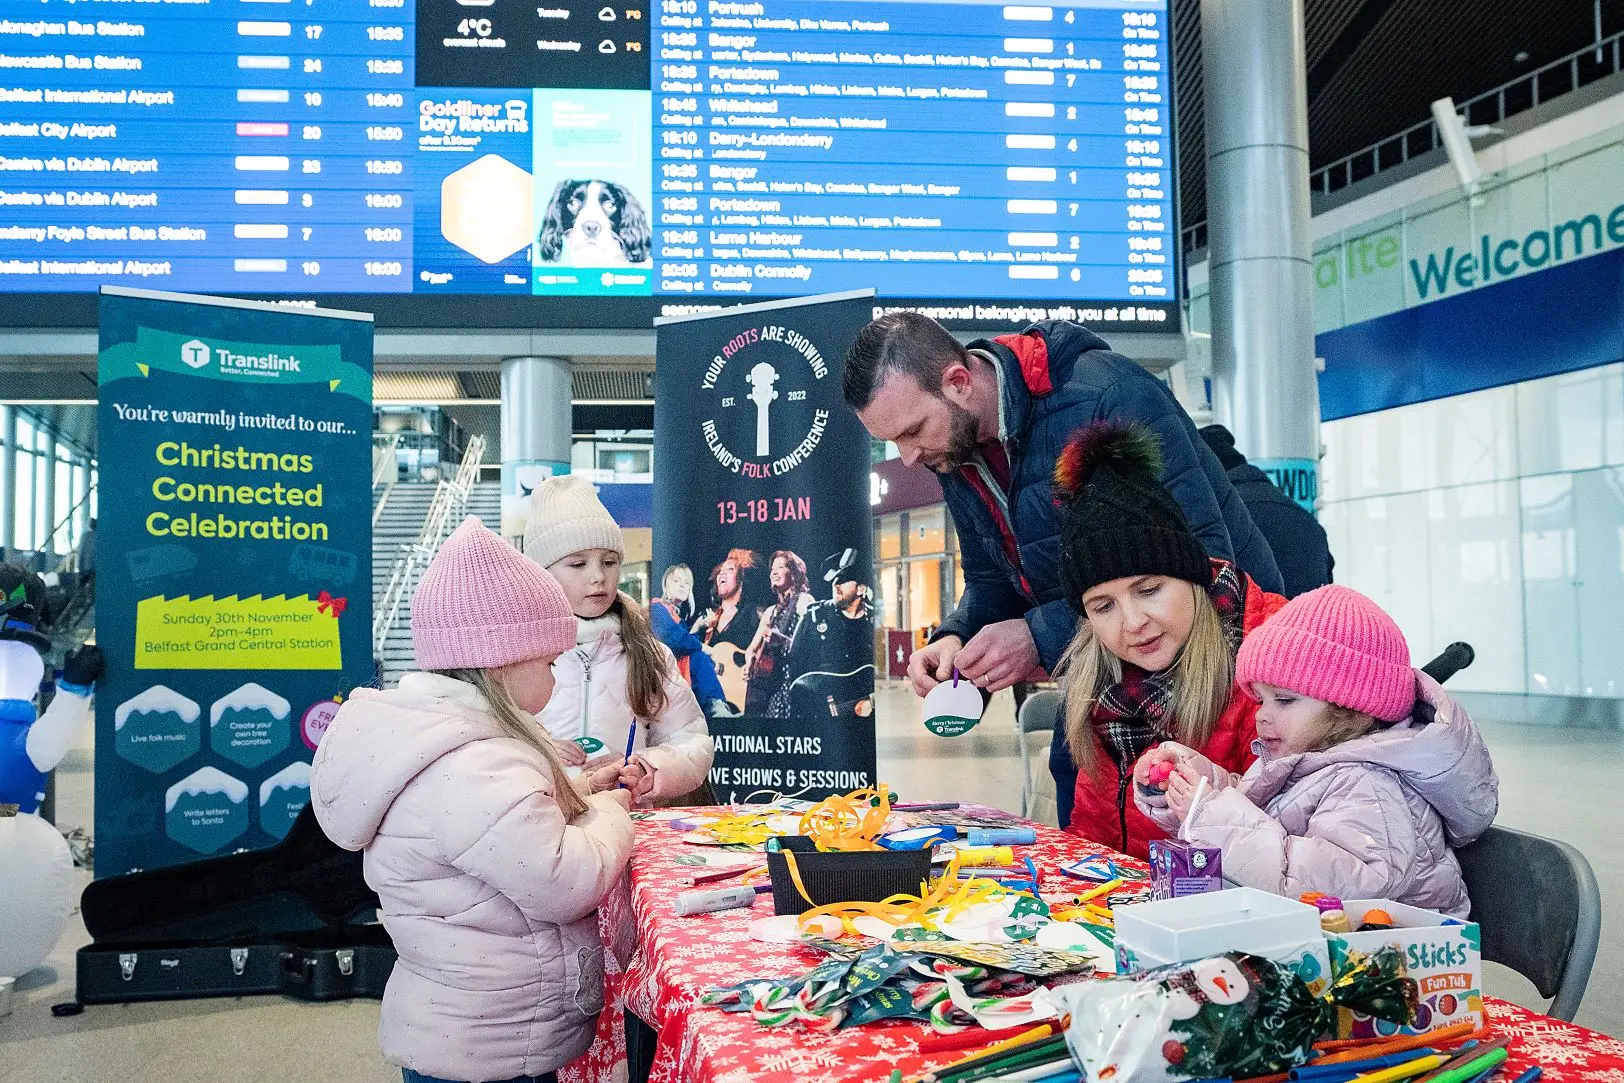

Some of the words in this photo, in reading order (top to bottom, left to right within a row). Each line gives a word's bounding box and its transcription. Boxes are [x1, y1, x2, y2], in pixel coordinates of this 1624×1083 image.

[709, 1, 763, 15] Portrush
[1065, 11, 1074, 23] 4
[68, 21, 95, 35] Bus
[97, 22, 144, 35] Station
[709, 33, 756, 49] Bangor
[1066, 43, 1074, 55] 1
[65, 55, 92, 69] Bus
[94, 56, 141, 69] Station
[709, 66, 779, 80] Portadown
[1066, 74, 1076, 87] 7
[45, 89, 126, 103] International
[128, 90, 173, 106] Airport
[305, 93, 321, 106] 10
[420, 101, 501, 115] Goldliner
[709, 99, 778, 113] Whitehead
[41, 123, 68, 139] City
[70, 123, 116, 139] Airport
[420, 116, 458, 137] Day
[460, 116, 528, 132] Returns
[1068, 139, 1077, 151] 4
[67, 157, 110, 171] Dublin
[112, 158, 158, 174] Airport
[710, 165, 757, 180] Bangor
[1069, 171, 1076, 184] 1
[67, 192, 110, 205] Dublin
[111, 192, 157, 208] Airport
[710, 198, 780, 211] Portadown
[1069, 204, 1079, 216] 7
[86, 226, 128, 240] Street
[129, 226, 157, 240] Bus
[156, 226, 206, 240] Station
[302, 228, 312, 240] 7
[710, 231, 747, 244] Larne
[750, 232, 802, 245] Harbour
[1410, 203, 1624, 300] Welcome
[41, 261, 123, 274] International
[124, 261, 171, 277] Airport
[302, 262, 320, 275] 10
[710, 264, 752, 277] Dublin
[754, 264, 811, 280] Connolly
[976, 306, 1046, 325] belongings
[1047, 306, 1076, 323] with
[1075, 309, 1102, 323] you
[1104, 308, 1118, 320] at
[1120, 307, 1135, 321] all
[1137, 307, 1166, 321] time
[215, 349, 301, 372] Translink
[701, 355, 727, 389] YOUR
[722, 327, 759, 359] ROOTS
[760, 325, 785, 341] ARE
[784, 330, 828, 380] SHOWING
[244, 368, 280, 378] Connected
[721, 397, 736, 408] EST.
[787, 390, 807, 401] 2022
[112, 403, 168, 422] You're
[171, 410, 236, 431] warmly
[239, 412, 296, 431] invited
[298, 416, 314, 432] to
[317, 421, 356, 435] our...
[701, 419, 742, 473] IRELAND'S
[741, 462, 771, 479] FOLK
[772, 408, 829, 476] CONFERENCE
[155, 442, 314, 473] Christmas
[152, 477, 323, 507] Connected
[717, 499, 768, 524] 13-18
[774, 497, 811, 521] JAN
[145, 512, 329, 541] Celebration
[163, 613, 212, 626] Sunday
[215, 612, 245, 624] 30th
[247, 611, 313, 623] November
[209, 626, 273, 639] 2pm-4pm
[144, 641, 191, 653] Belfast
[194, 640, 236, 652] Grand
[238, 639, 287, 650] Central
[289, 638, 334, 649] Station
[229, 722, 255, 730] Create
[255, 721, 273, 730] your
[131, 735, 148, 743] Live
[148, 734, 163, 742] folk
[235, 730, 251, 738] own
[231, 738, 272, 747] decoration
[711, 735, 773, 754] ATIONAL
[776, 736, 822, 755] STARS
[732, 767, 782, 787] SHOWS
[786, 769, 797, 786] &
[799, 770, 868, 789] SESSIONS
[183, 809, 205, 817] Write
[205, 808, 230, 816] letters
[191, 818, 201, 826] to
[201, 817, 224, 825] Santa
[1407, 941, 1467, 970] Sticks
[1426, 978, 1447, 991] Fun
[1448, 974, 1467, 987] Tub
